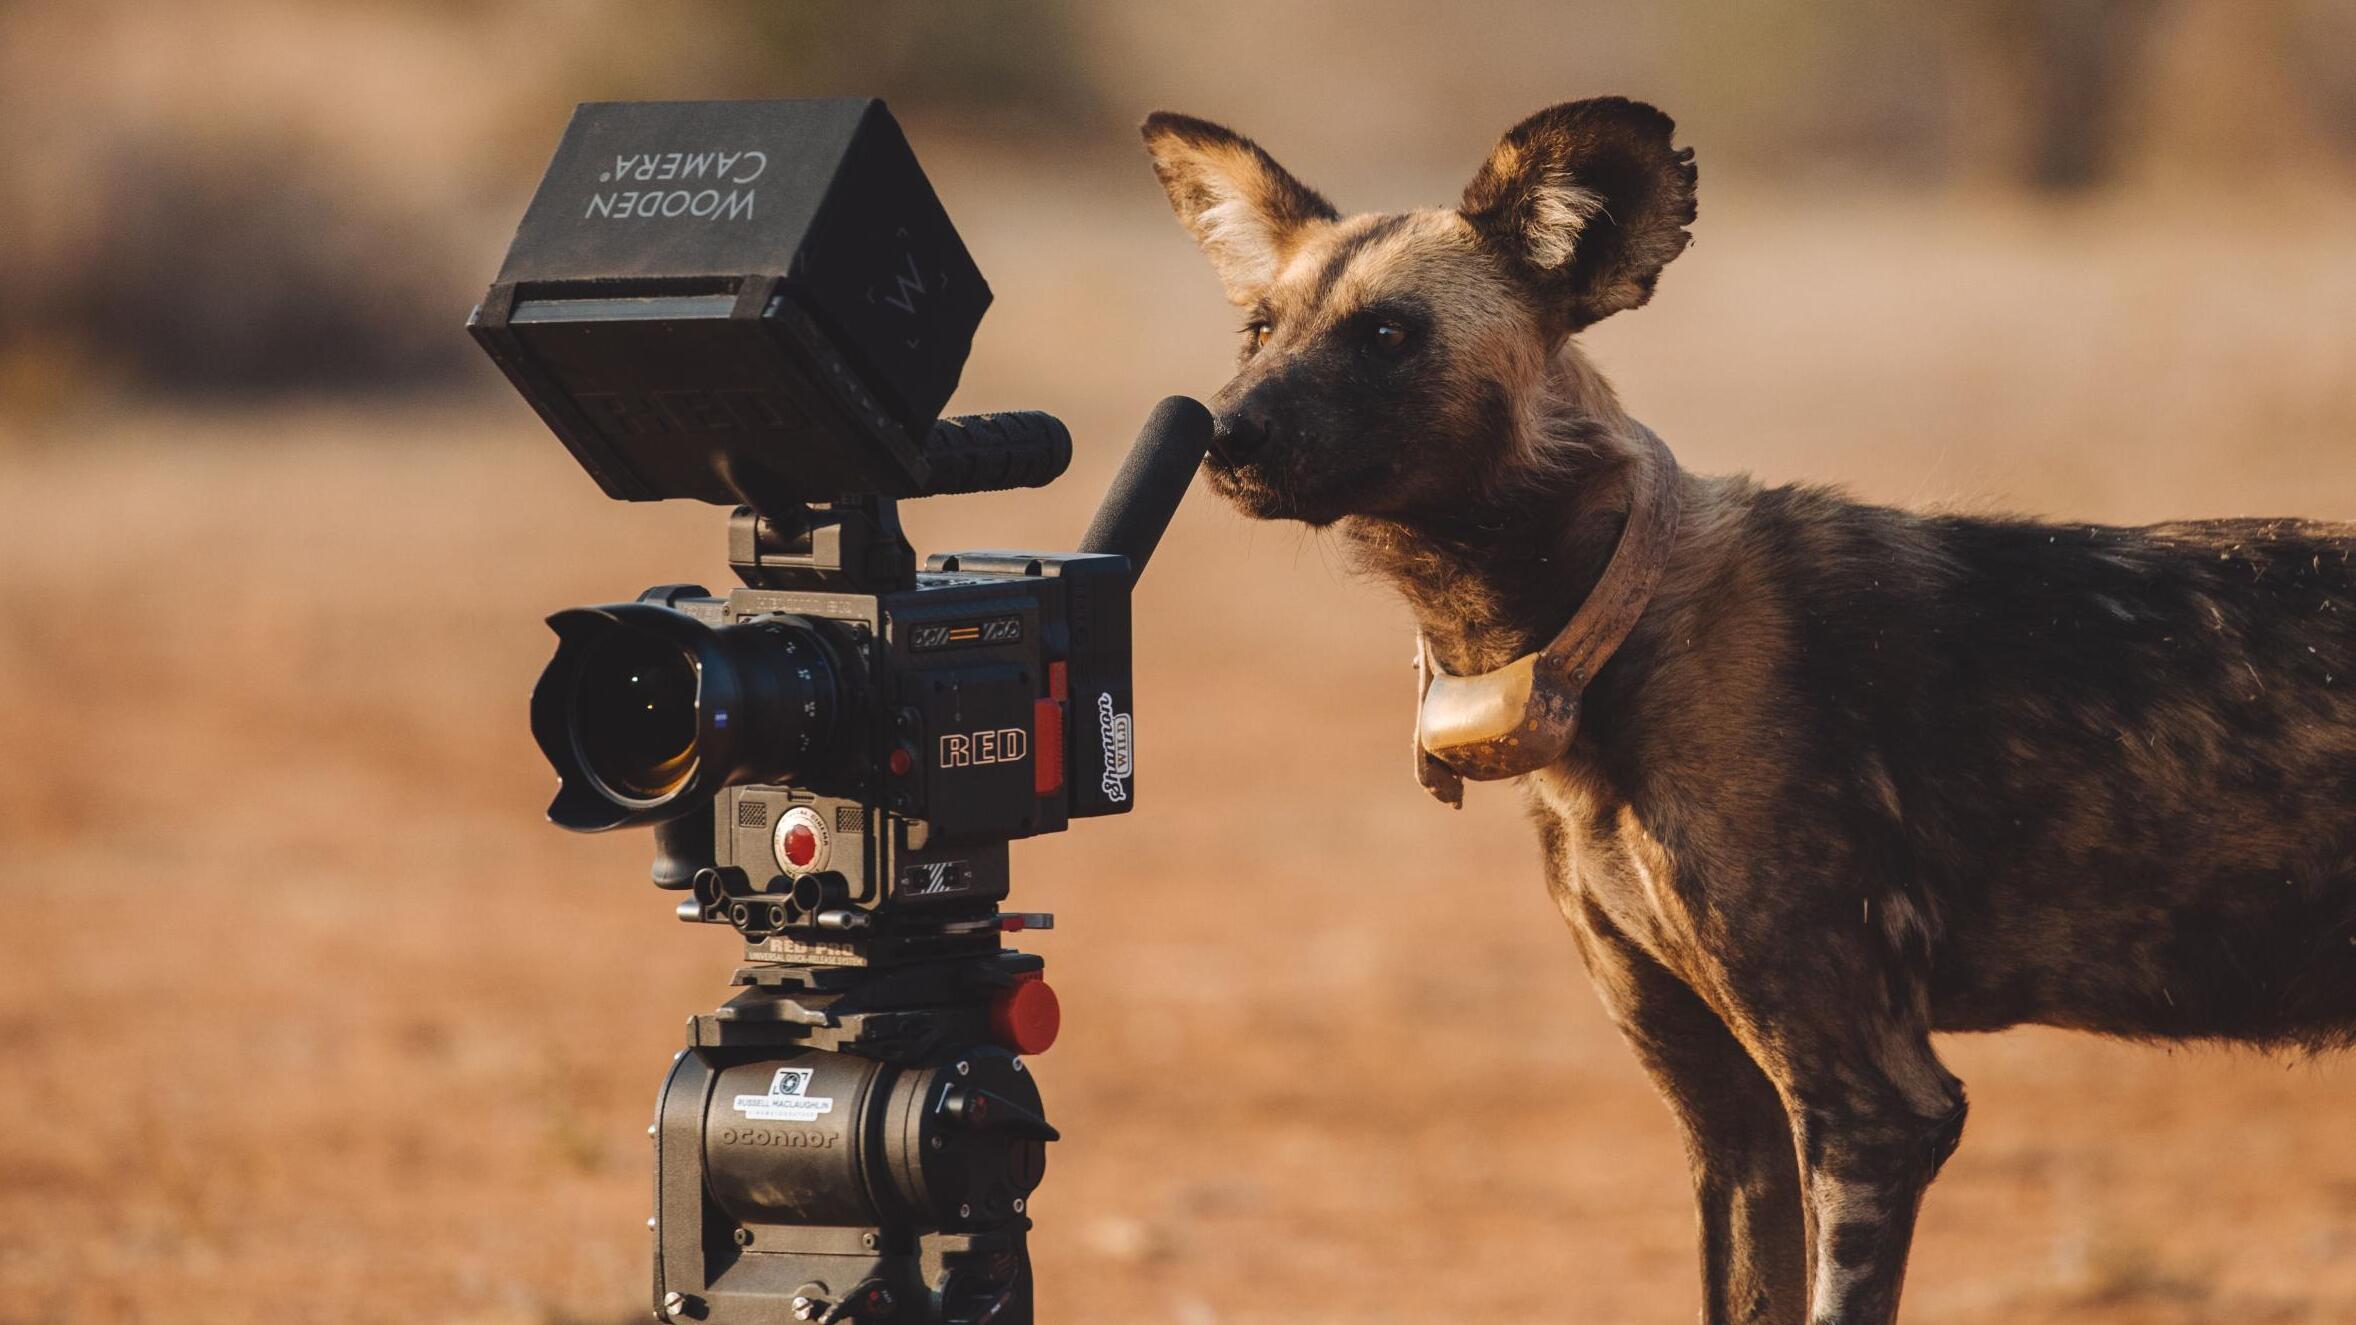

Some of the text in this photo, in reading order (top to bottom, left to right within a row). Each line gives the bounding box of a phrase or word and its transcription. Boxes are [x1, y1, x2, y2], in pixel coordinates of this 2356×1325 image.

[584, 188, 755, 221] WOODEN
[939, 727, 1027, 768] RED
[1099, 693, 1126, 800] Shannon
[1116, 720, 1127, 767] WILD
